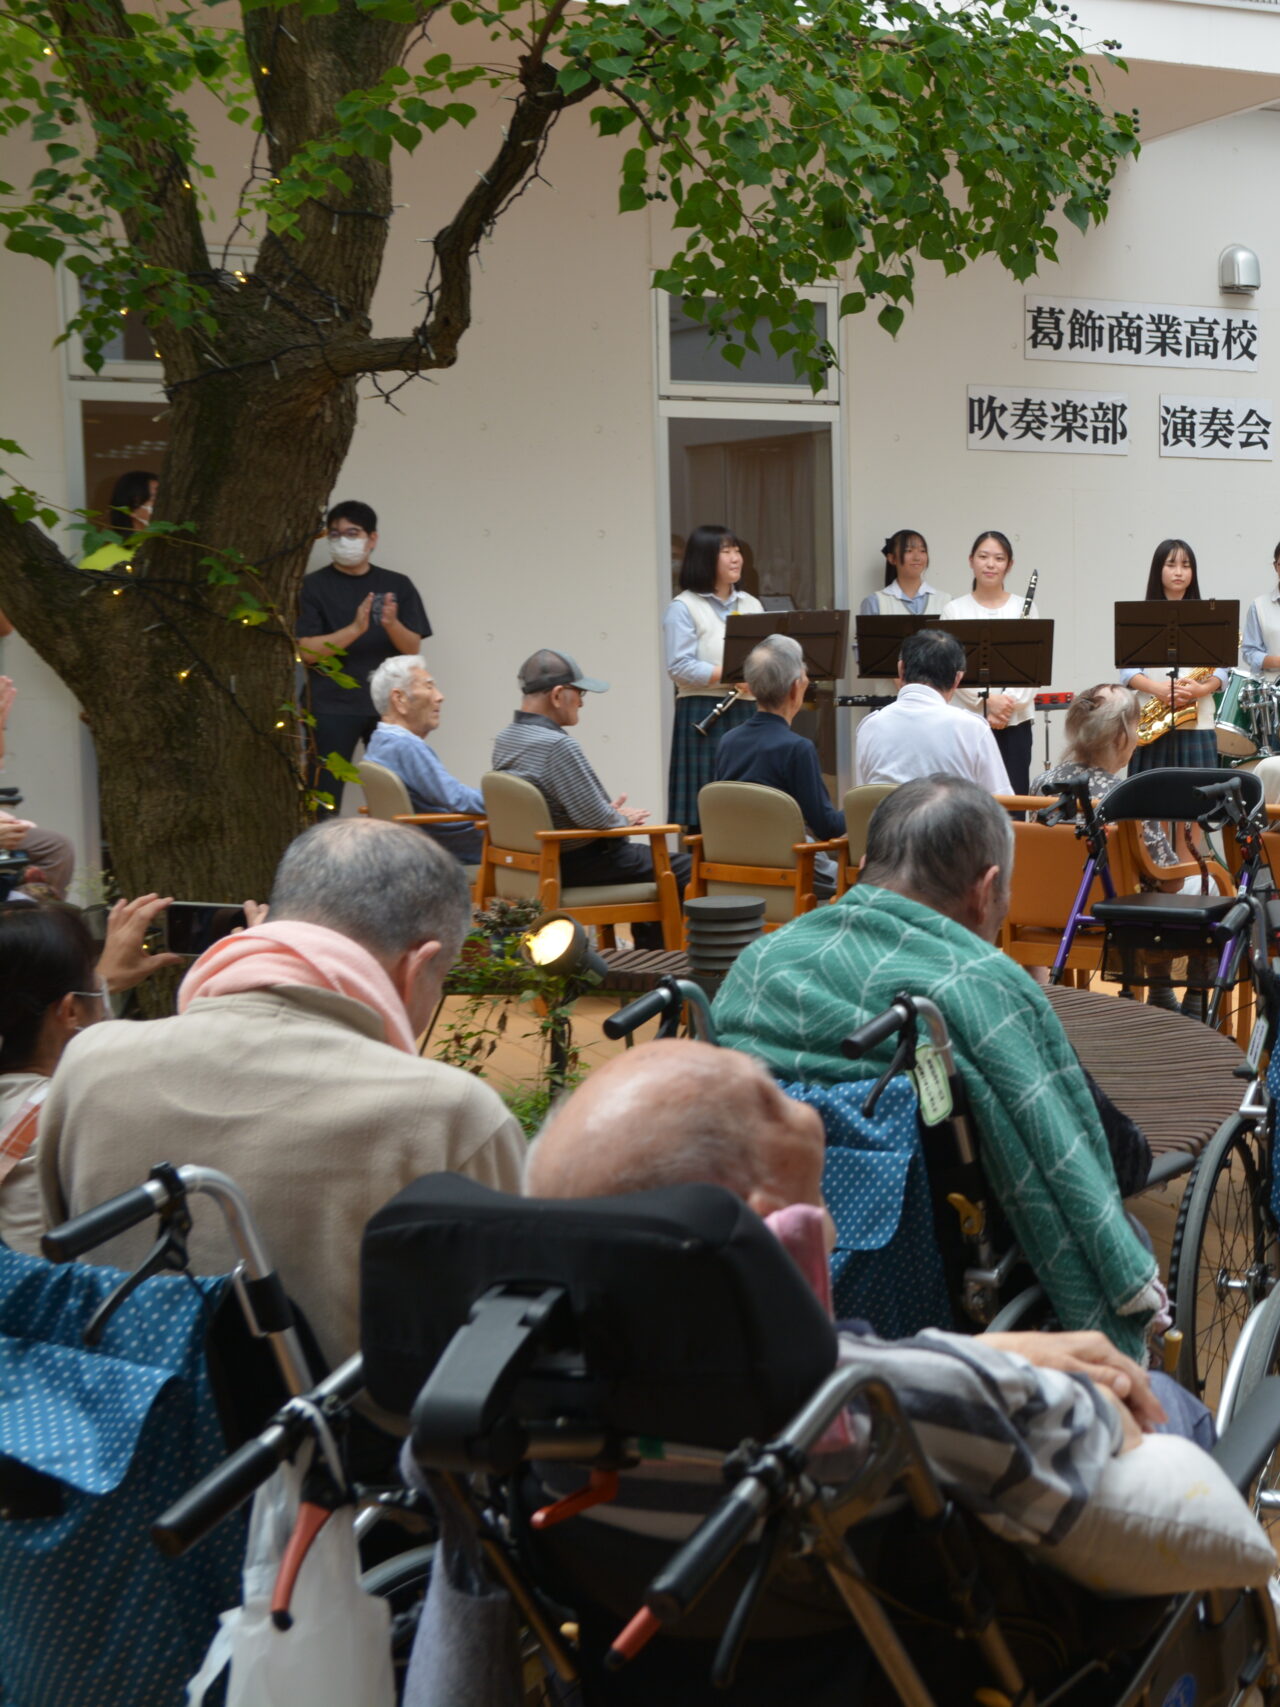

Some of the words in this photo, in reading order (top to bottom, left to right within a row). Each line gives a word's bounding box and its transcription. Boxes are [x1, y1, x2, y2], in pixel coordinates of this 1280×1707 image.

[1026, 306, 1258, 361] 葛飾商業高校
[968, 396, 1128, 446] 吹奏楽部
[1160, 405, 1272, 450] 演奏会
